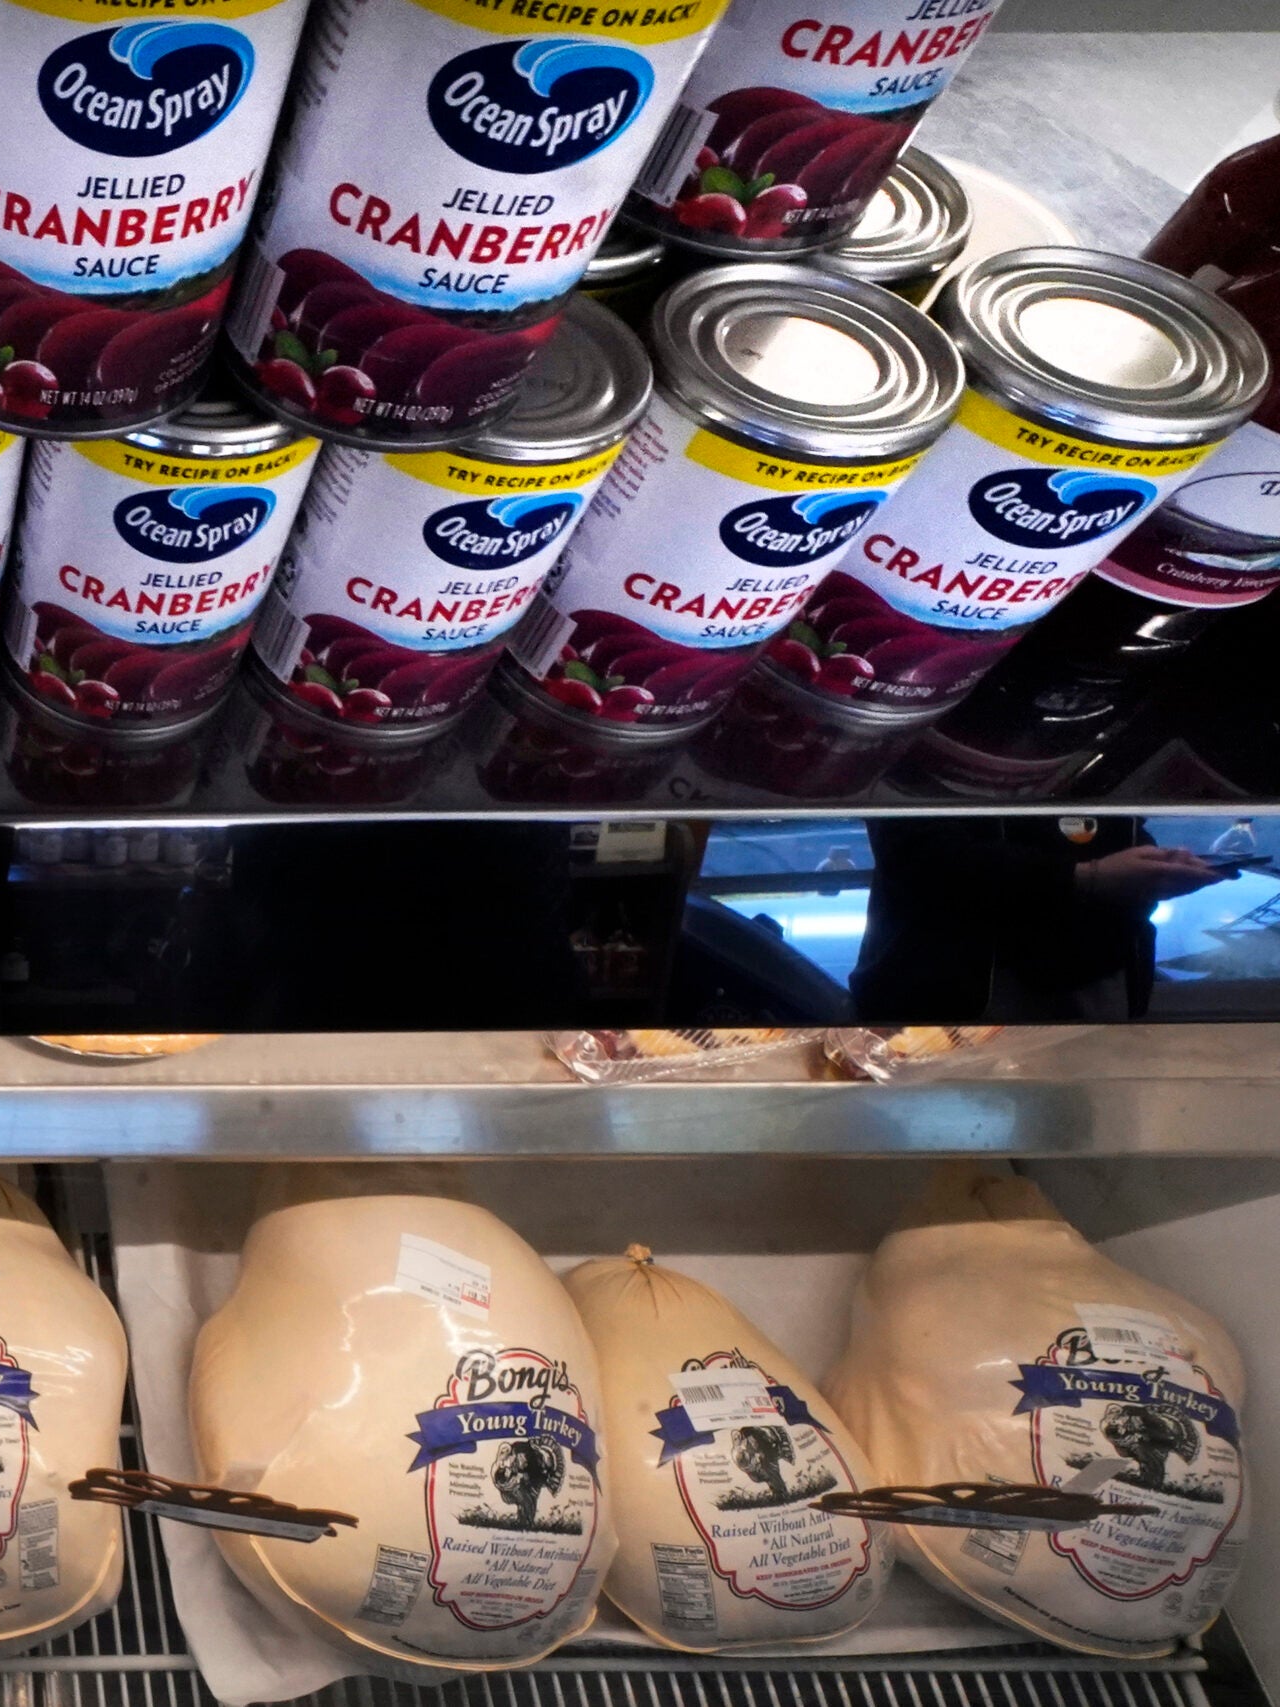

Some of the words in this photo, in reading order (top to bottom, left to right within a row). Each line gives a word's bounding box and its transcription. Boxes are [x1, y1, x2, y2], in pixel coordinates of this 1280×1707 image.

[511, 0, 597, 26] RECIPE
[602, 9, 638, 27] ON
[869, 67, 944, 97] SAUCE
[53, 62, 141, 130] Ocean
[146, 63, 230, 136] Spray
[444, 72, 526, 147] Ocean
[531, 90, 627, 156] Spray
[77, 173, 186, 200] JELLIED
[442, 186, 556, 216] JELLIED
[73, 254, 161, 278] SAUCE
[419, 268, 510, 295] SAUCE
[1015, 427, 1052, 453] TRY
[1056, 440, 1124, 468] RECIPE
[1125, 456, 1152, 467] ON
[124, 453, 155, 473] TRY
[159, 464, 221, 480] RECIPE
[225, 466, 251, 478] ON
[447, 465, 481, 484] TRY
[484, 475, 546, 488] RECIPE
[549, 473, 571, 485] ON
[756, 461, 793, 480] TRY
[794, 471, 859, 484] RECIPE
[861, 471, 884, 483] ON
[984, 482, 1053, 532] Ocean
[1048, 500, 1136, 540] Spray
[125, 505, 191, 548] Ocean
[195, 507, 259, 551] Spray
[436, 516, 503, 556] Ocean
[502, 511, 568, 557] Spray
[733, 511, 803, 553] Ocean
[799, 508, 871, 555] Spray
[964, 551, 1058, 575] JELLIED
[140, 571, 223, 589] JELLIED
[439, 575, 519, 596] JELLIED
[725, 573, 810, 593] JELLIED
[931, 600, 1007, 621] SAUCE
[135, 618, 204, 634] SAUCE
[422, 623, 488, 641] SAUCE
[699, 622, 766, 639] SAUCE
[1059, 1372, 1141, 1400] Young
[1147, 1378, 1219, 1421] Turkey
[457, 1413, 528, 1435] Young
[533, 1409, 583, 1446] Turkey
[711, 1522, 757, 1539] Raised
[760, 1518, 806, 1534] Without
[791, 1523, 834, 1545] Natural
[442, 1536, 487, 1555] Raised
[489, 1541, 533, 1558] Without
[748, 1554, 768, 1569] All
[771, 1545, 827, 1567] Vegetable
[829, 1537, 851, 1555] Diet
[510, 1560, 553, 1575] Natural
[461, 1573, 481, 1585] All
[532, 1577, 557, 1591] Diet
